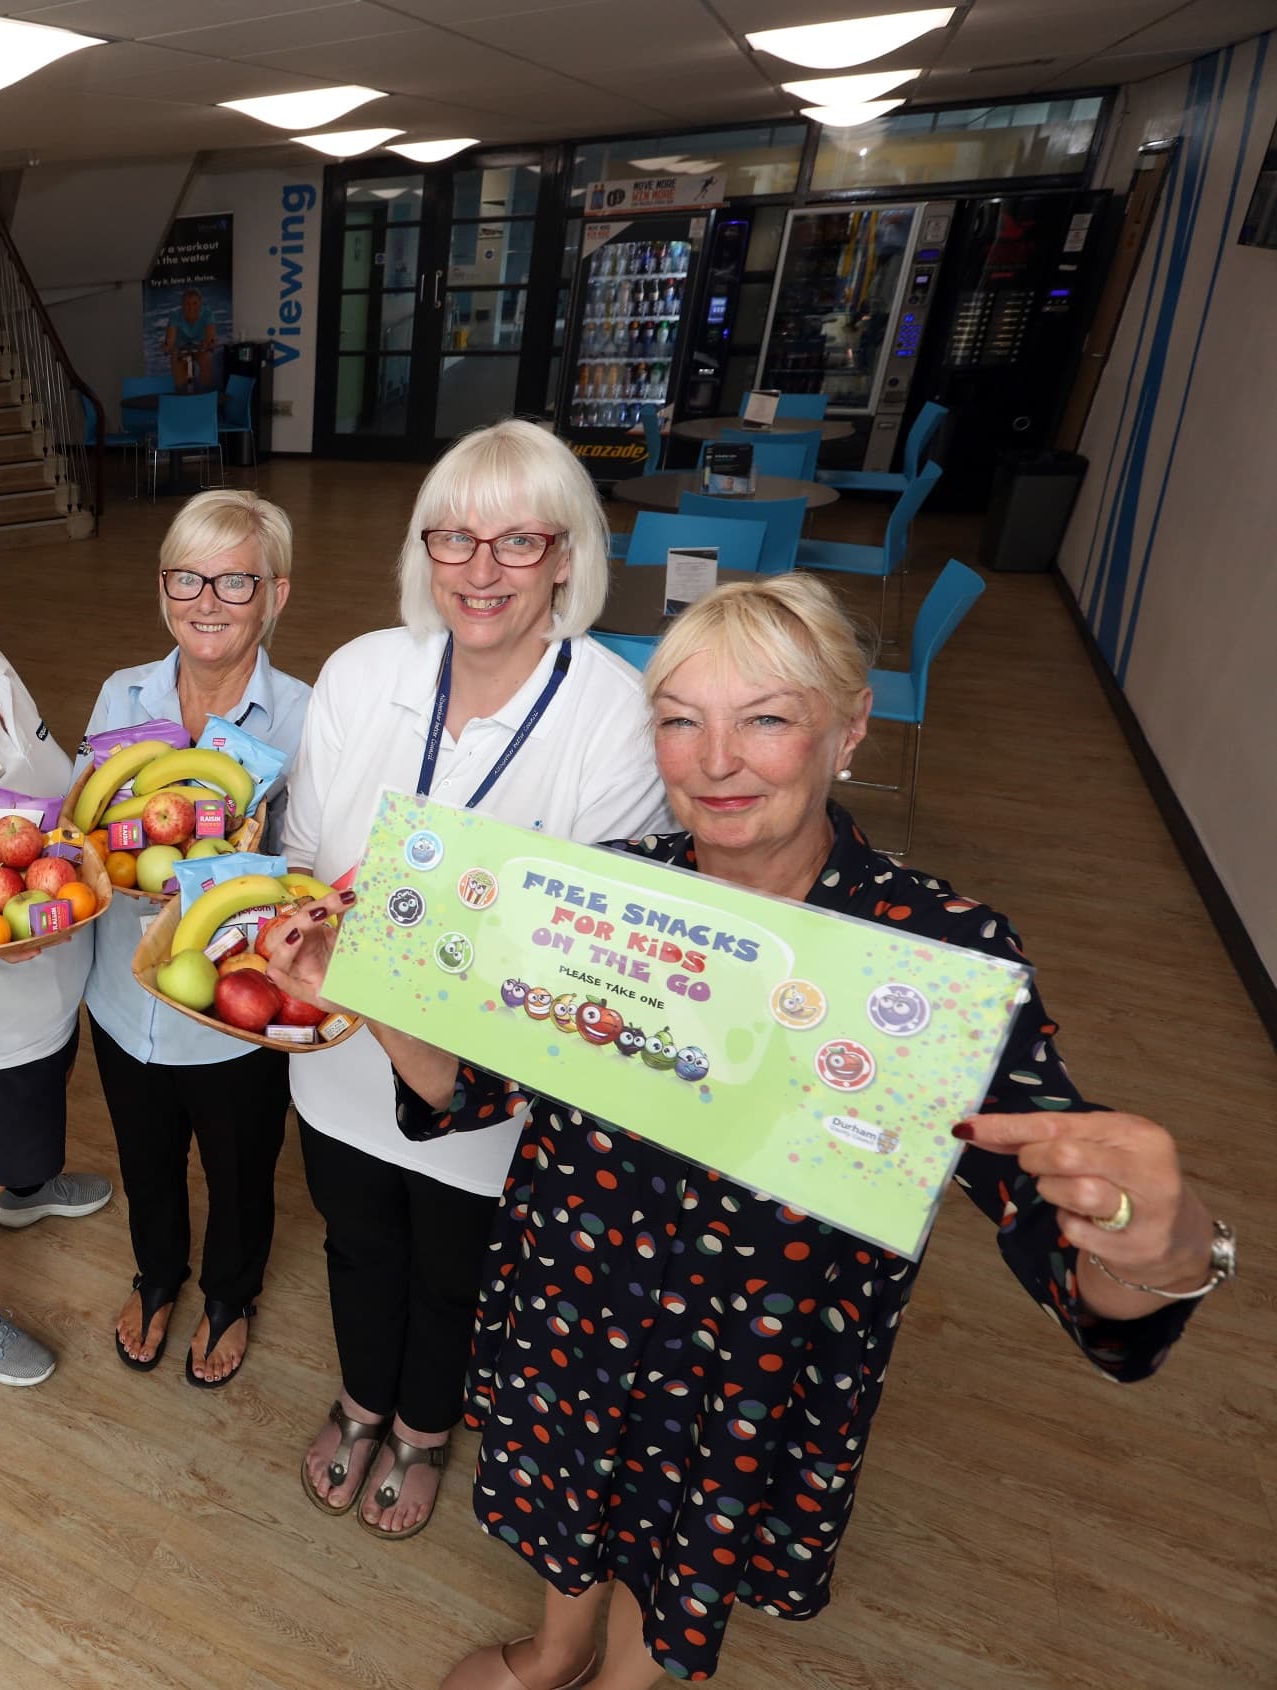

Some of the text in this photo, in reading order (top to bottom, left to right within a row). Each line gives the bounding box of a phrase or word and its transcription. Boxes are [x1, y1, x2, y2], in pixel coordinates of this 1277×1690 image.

[162, 255, 180, 265] the
[181, 254, 211, 264] water
[177, 240, 219, 253] workout
[267, 184, 316, 368] Viewing
[571, 442, 646, 459] ucozade
[200, 815, 222, 823] RAISIN
[522, 871, 760, 962] FREE SNACKS
[551, 906, 615, 941] FOR
[531, 927, 711, 1002] ON THE GO
[559, 965, 665, 1010] PLEASE TAKE ONE
[832, 1117, 877, 1140] Durham
